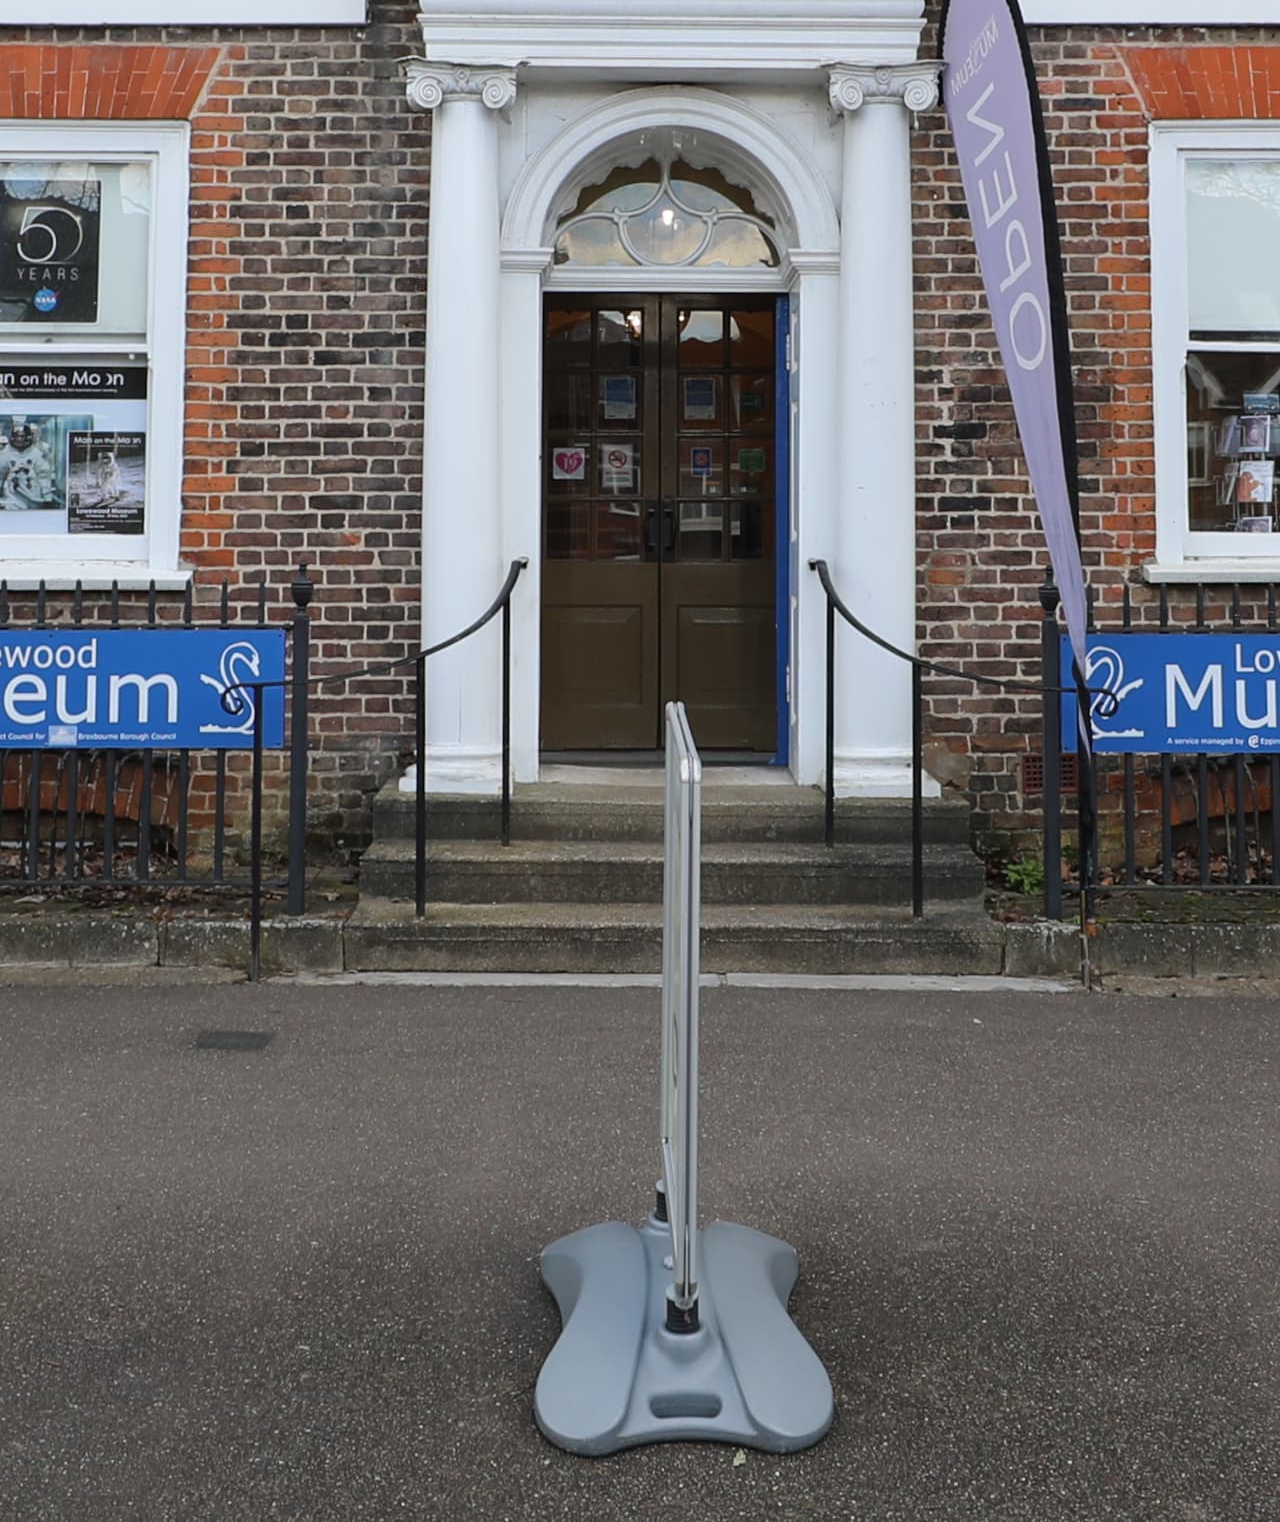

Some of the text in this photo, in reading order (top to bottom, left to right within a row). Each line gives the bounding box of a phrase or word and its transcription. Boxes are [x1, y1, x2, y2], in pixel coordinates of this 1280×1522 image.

[17, 206, 83, 264] 50
[16, 267, 80, 281] YEARS
[20, 374, 39, 385] on
[43, 372, 67, 385] the
[8, 733, 34, 741] Council
[35, 733, 46, 741] for
[78, 733, 118, 741] Broxbourne
[120, 733, 150, 743] Borough
[151, 733, 177, 741] Council
[1167, 737, 1173, 745] A
[1174, 737, 1199, 745] service
[1200, 737, 1233, 747] managed
[1235, 737, 1244, 746] by
